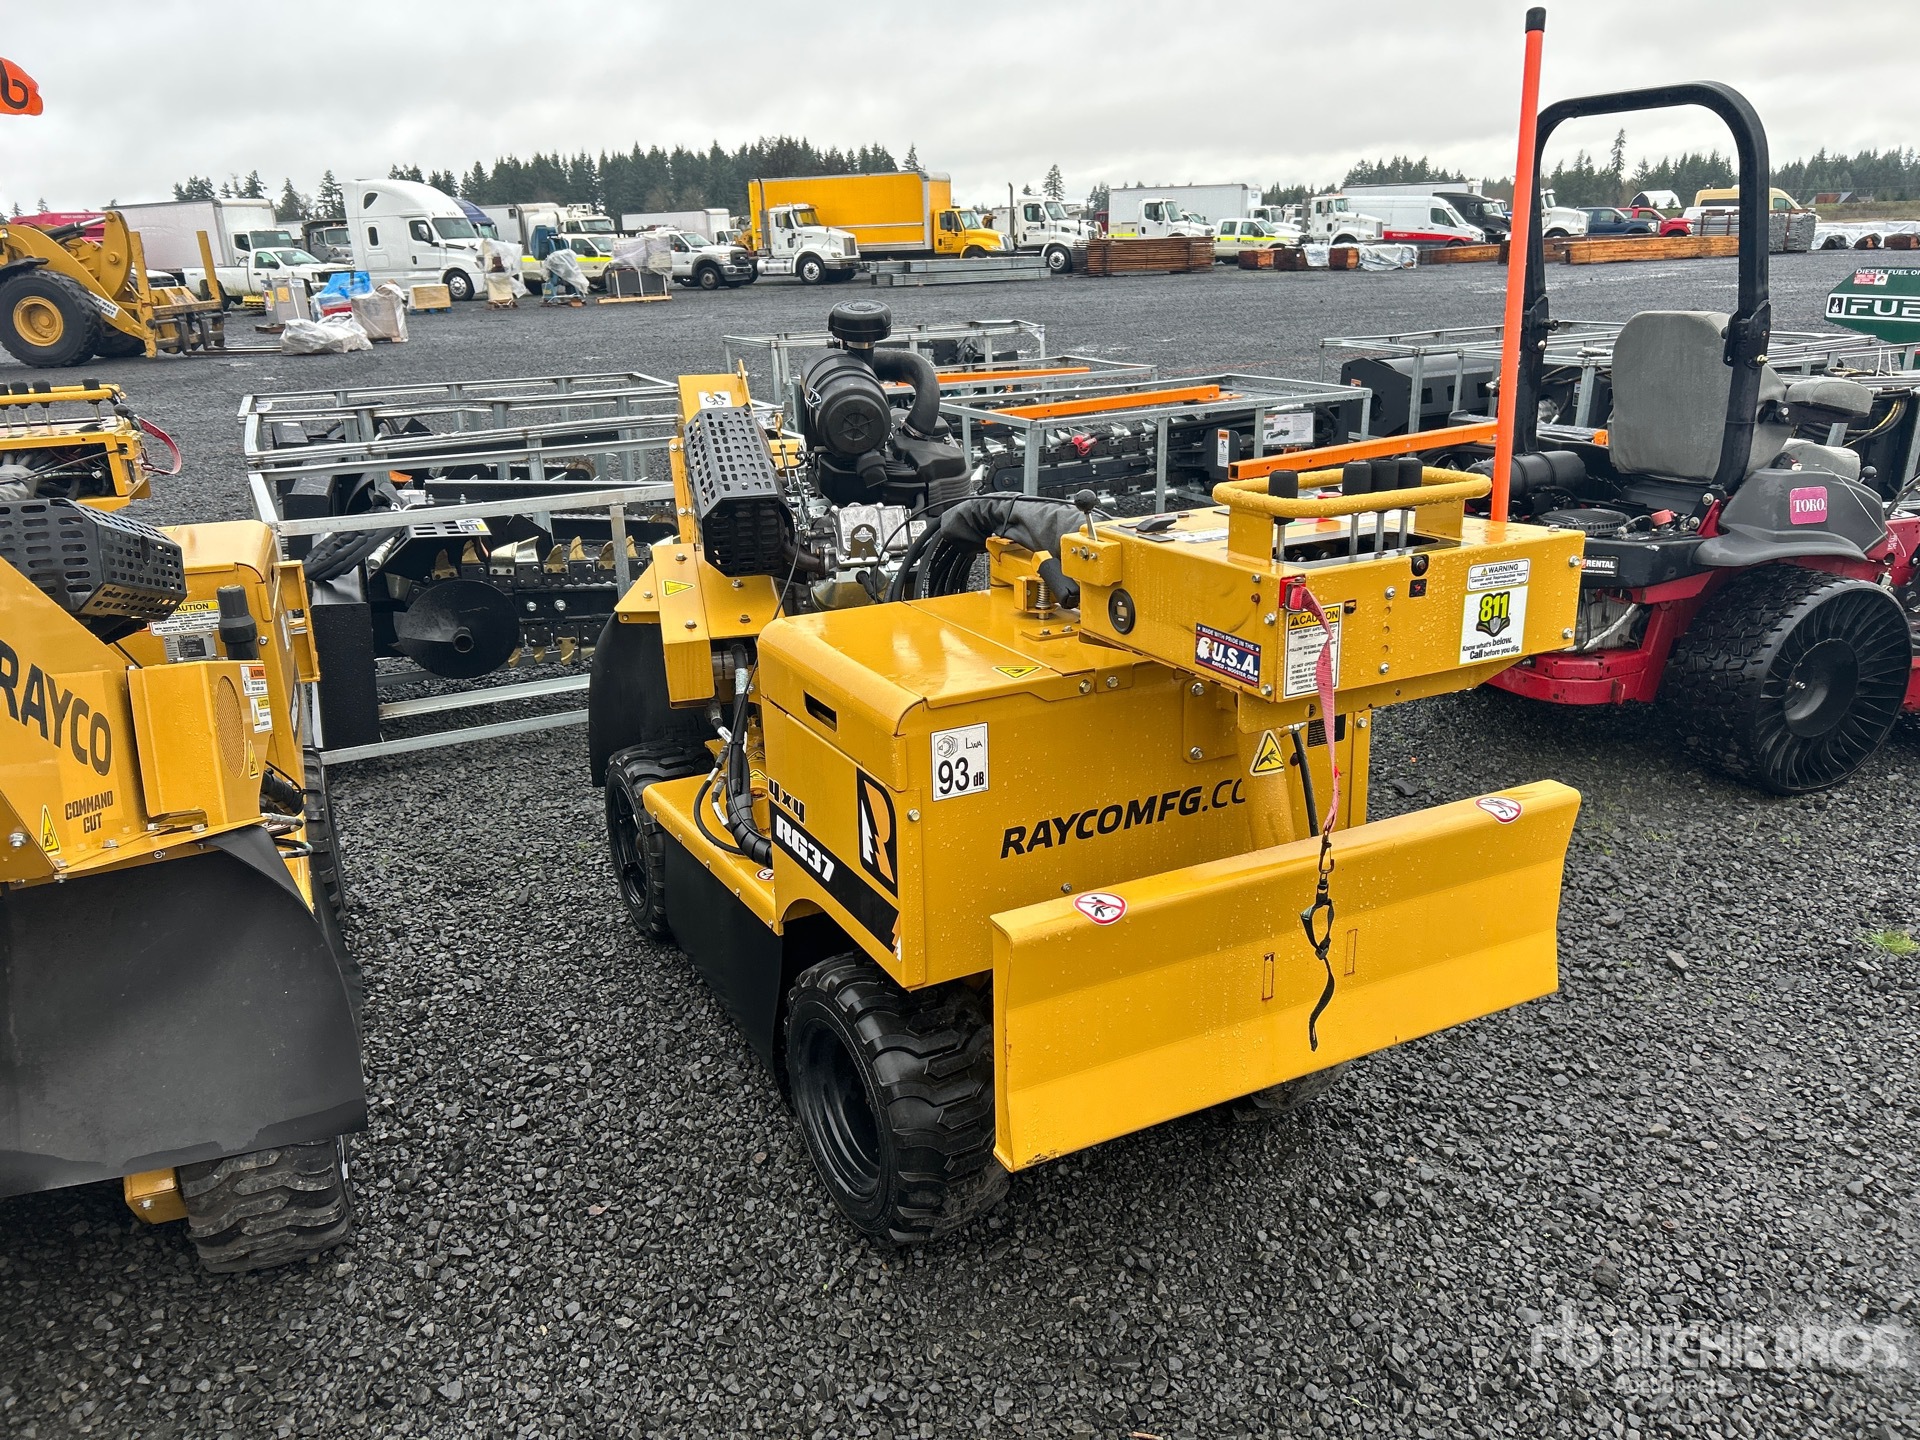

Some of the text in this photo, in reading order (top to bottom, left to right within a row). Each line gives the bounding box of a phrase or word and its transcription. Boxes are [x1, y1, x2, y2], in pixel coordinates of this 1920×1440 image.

[1488, 564, 1519, 574] WARNING
[1586, 560, 1615, 569] RENTAL
[176, 603, 209, 612] AUTION
[1299, 610, 1338, 625] CAUON
[1480, 593, 1509, 622] 811
[1202, 626, 1214, 636] MADE
[1214, 631, 1225, 640] WITH
[1225, 635, 1239, 645] PRIDE
[1245, 641, 1255, 651] THE
[1476, 641, 1492, 649] what's
[1492, 637, 1512, 647] below.
[1211, 641, 1259, 676] U.S.A.
[1470, 645, 1520, 660] Call before you dig.
[0, 640, 112, 776] RAYCO
[938, 756, 985, 795] 93 dB
[65, 790, 114, 821] COMMAND
[82, 812, 102, 834] CUT
[776, 814, 835, 882] RG37
